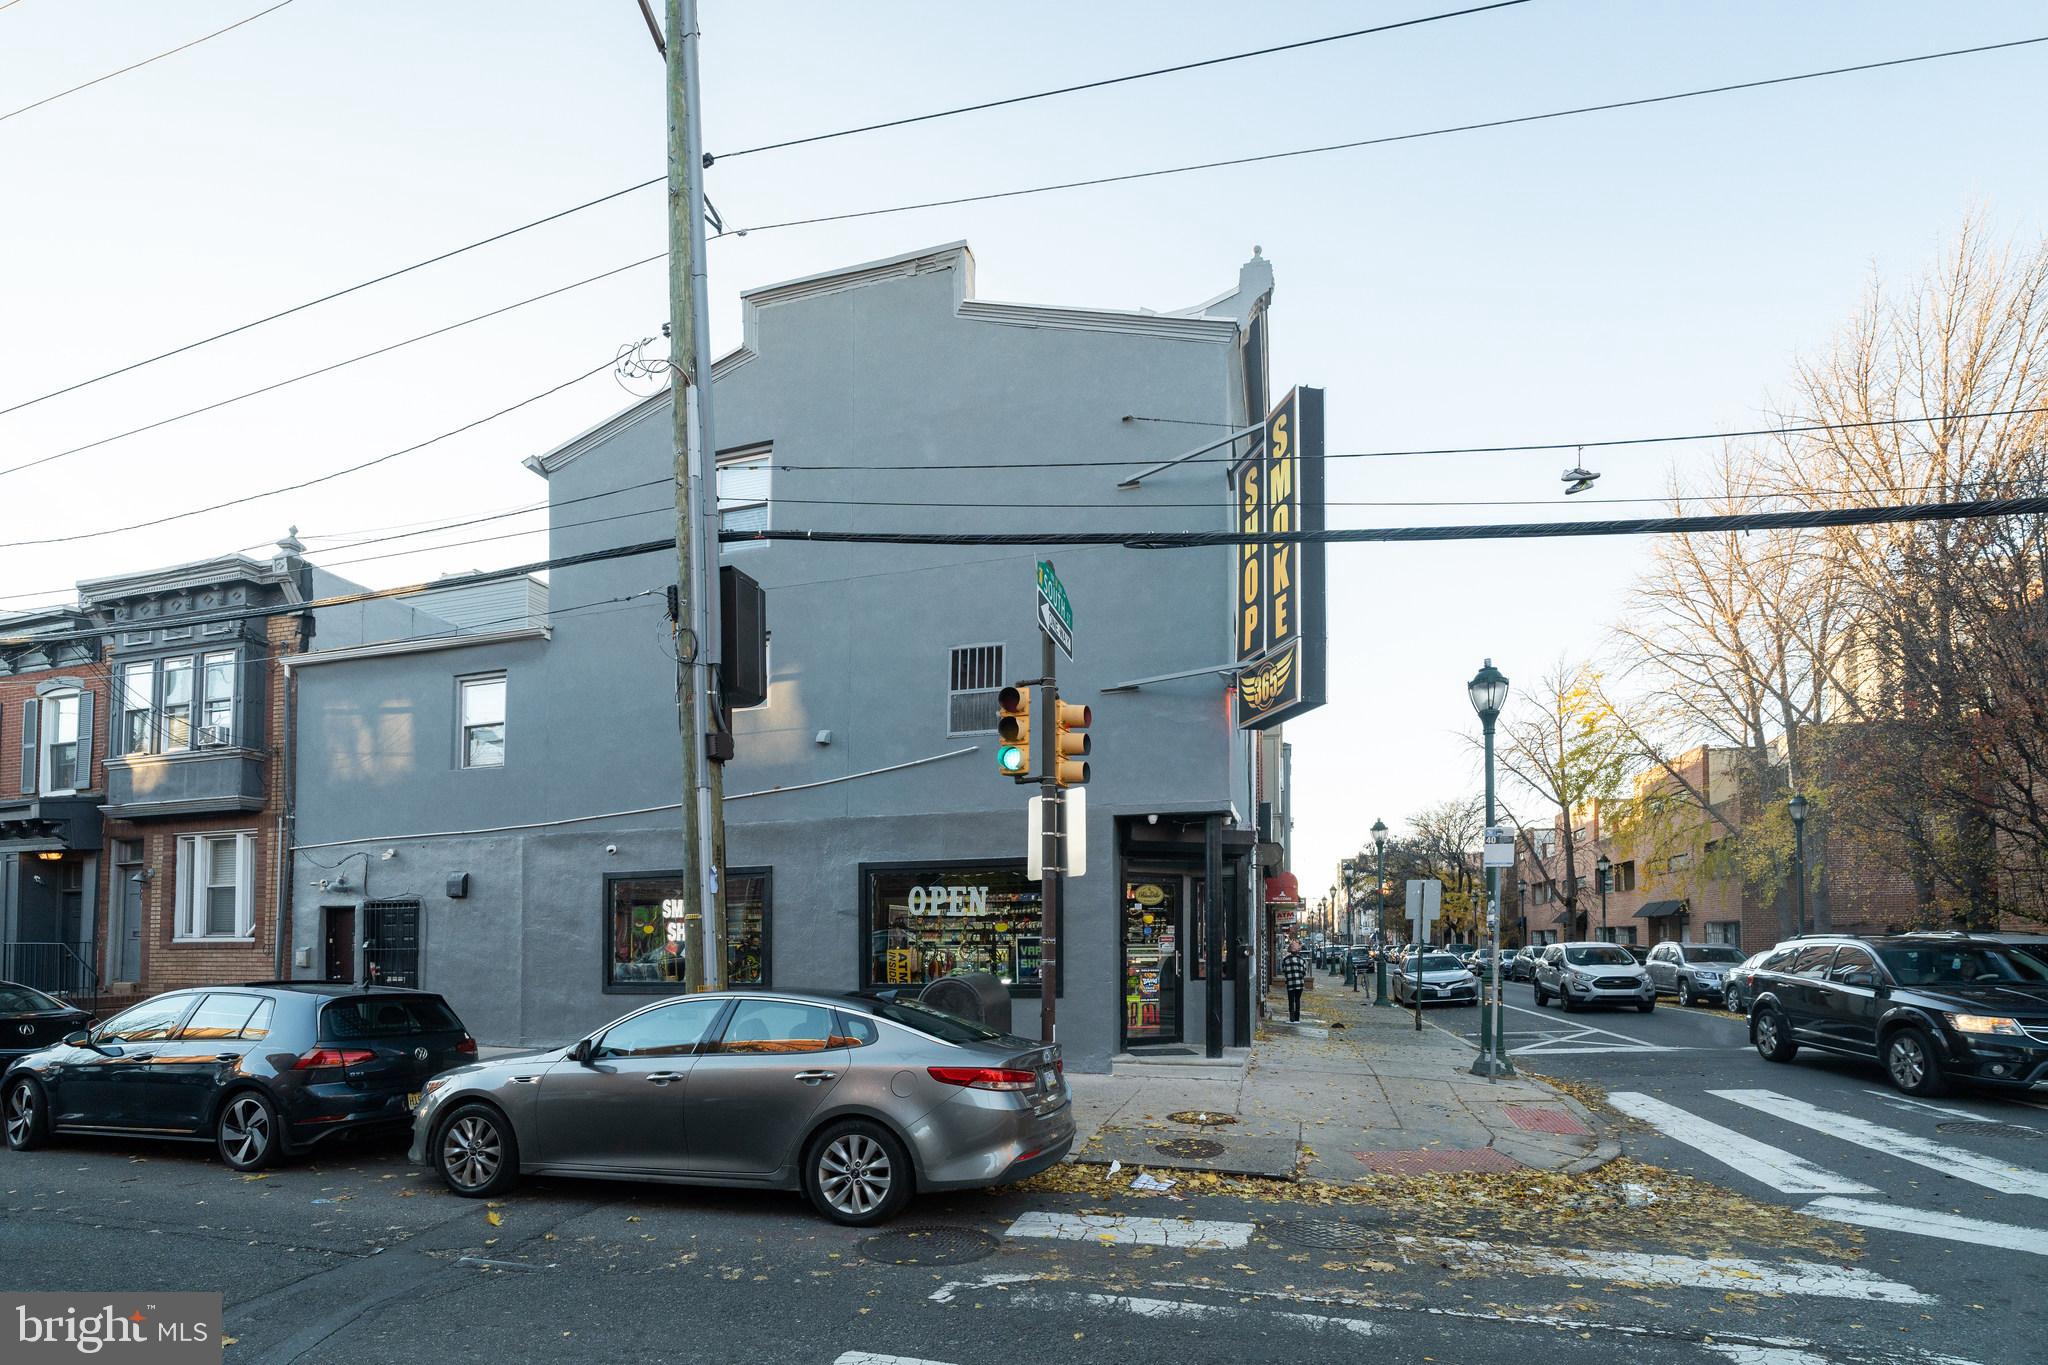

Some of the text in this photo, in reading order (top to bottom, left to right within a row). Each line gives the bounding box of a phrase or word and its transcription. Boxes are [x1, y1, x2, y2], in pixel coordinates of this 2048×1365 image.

[1271, 414, 1290, 639] SMOKE
[1244, 466, 1258, 650] SHOP
[1044, 573, 1066, 620] SOUTH
[1254, 667, 1277, 705] 365
[1485, 836, 1497, 844] 40
[908, 886, 989, 917] OPEN
[1020, 945, 1042, 955] VAP
[889, 951, 897, 984] INSIDE
[898, 953, 908, 984] ATM
